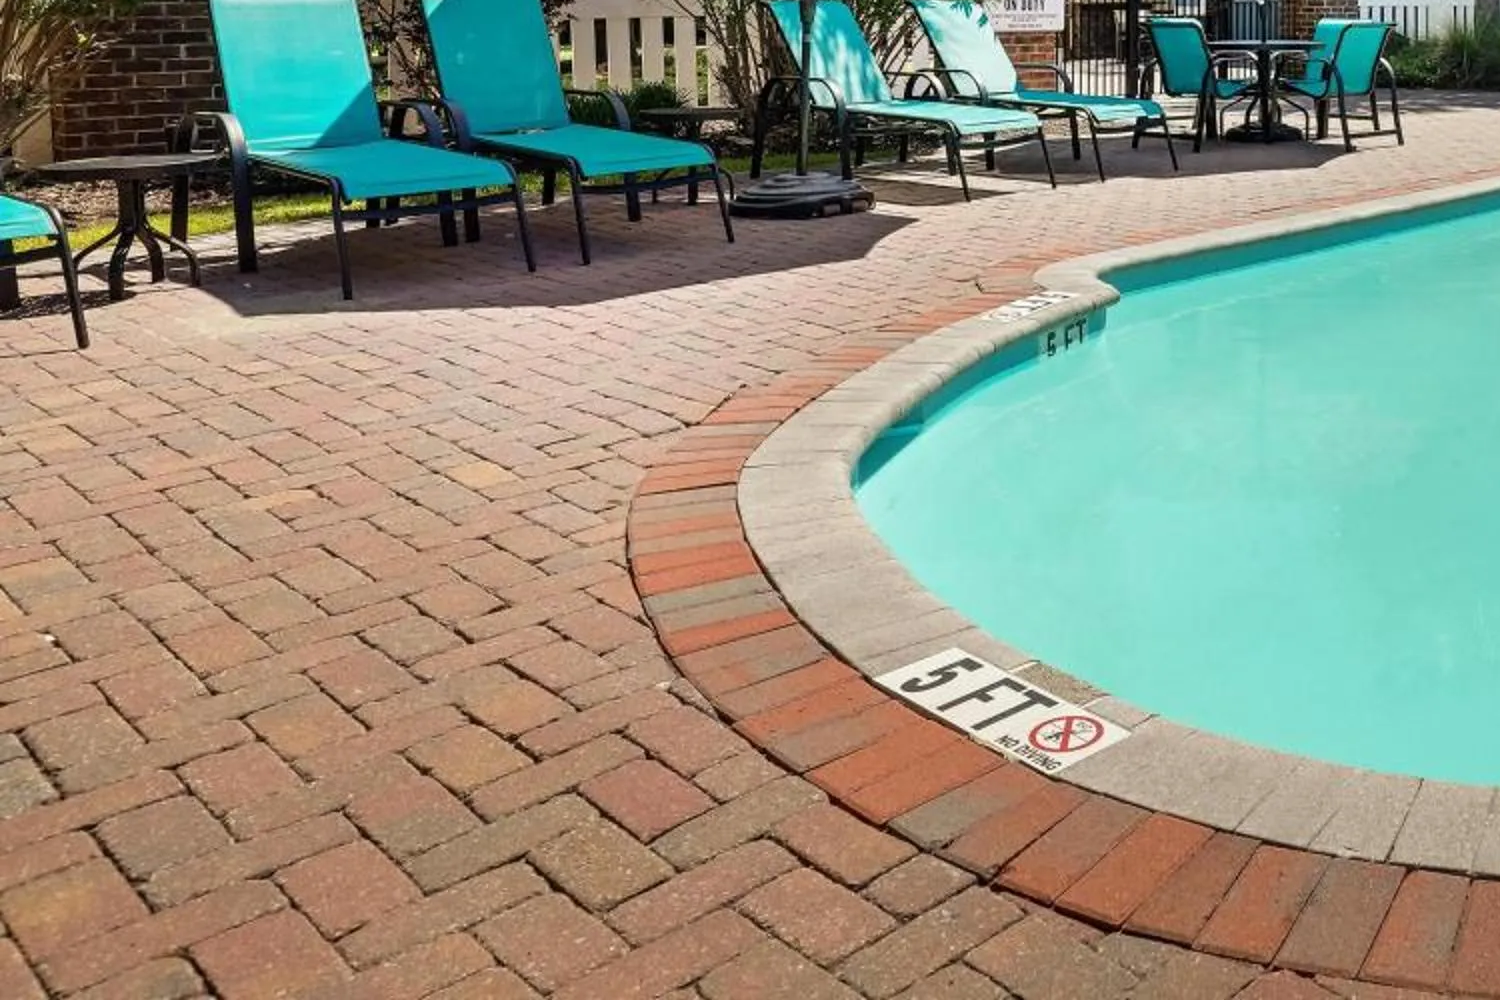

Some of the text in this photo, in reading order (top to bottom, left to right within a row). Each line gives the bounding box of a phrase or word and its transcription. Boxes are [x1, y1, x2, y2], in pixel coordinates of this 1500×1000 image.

[1064, 318, 1087, 351] FT
[900, 657, 1059, 730] 5 FT
[995, 735, 1062, 771] NO DIVING
